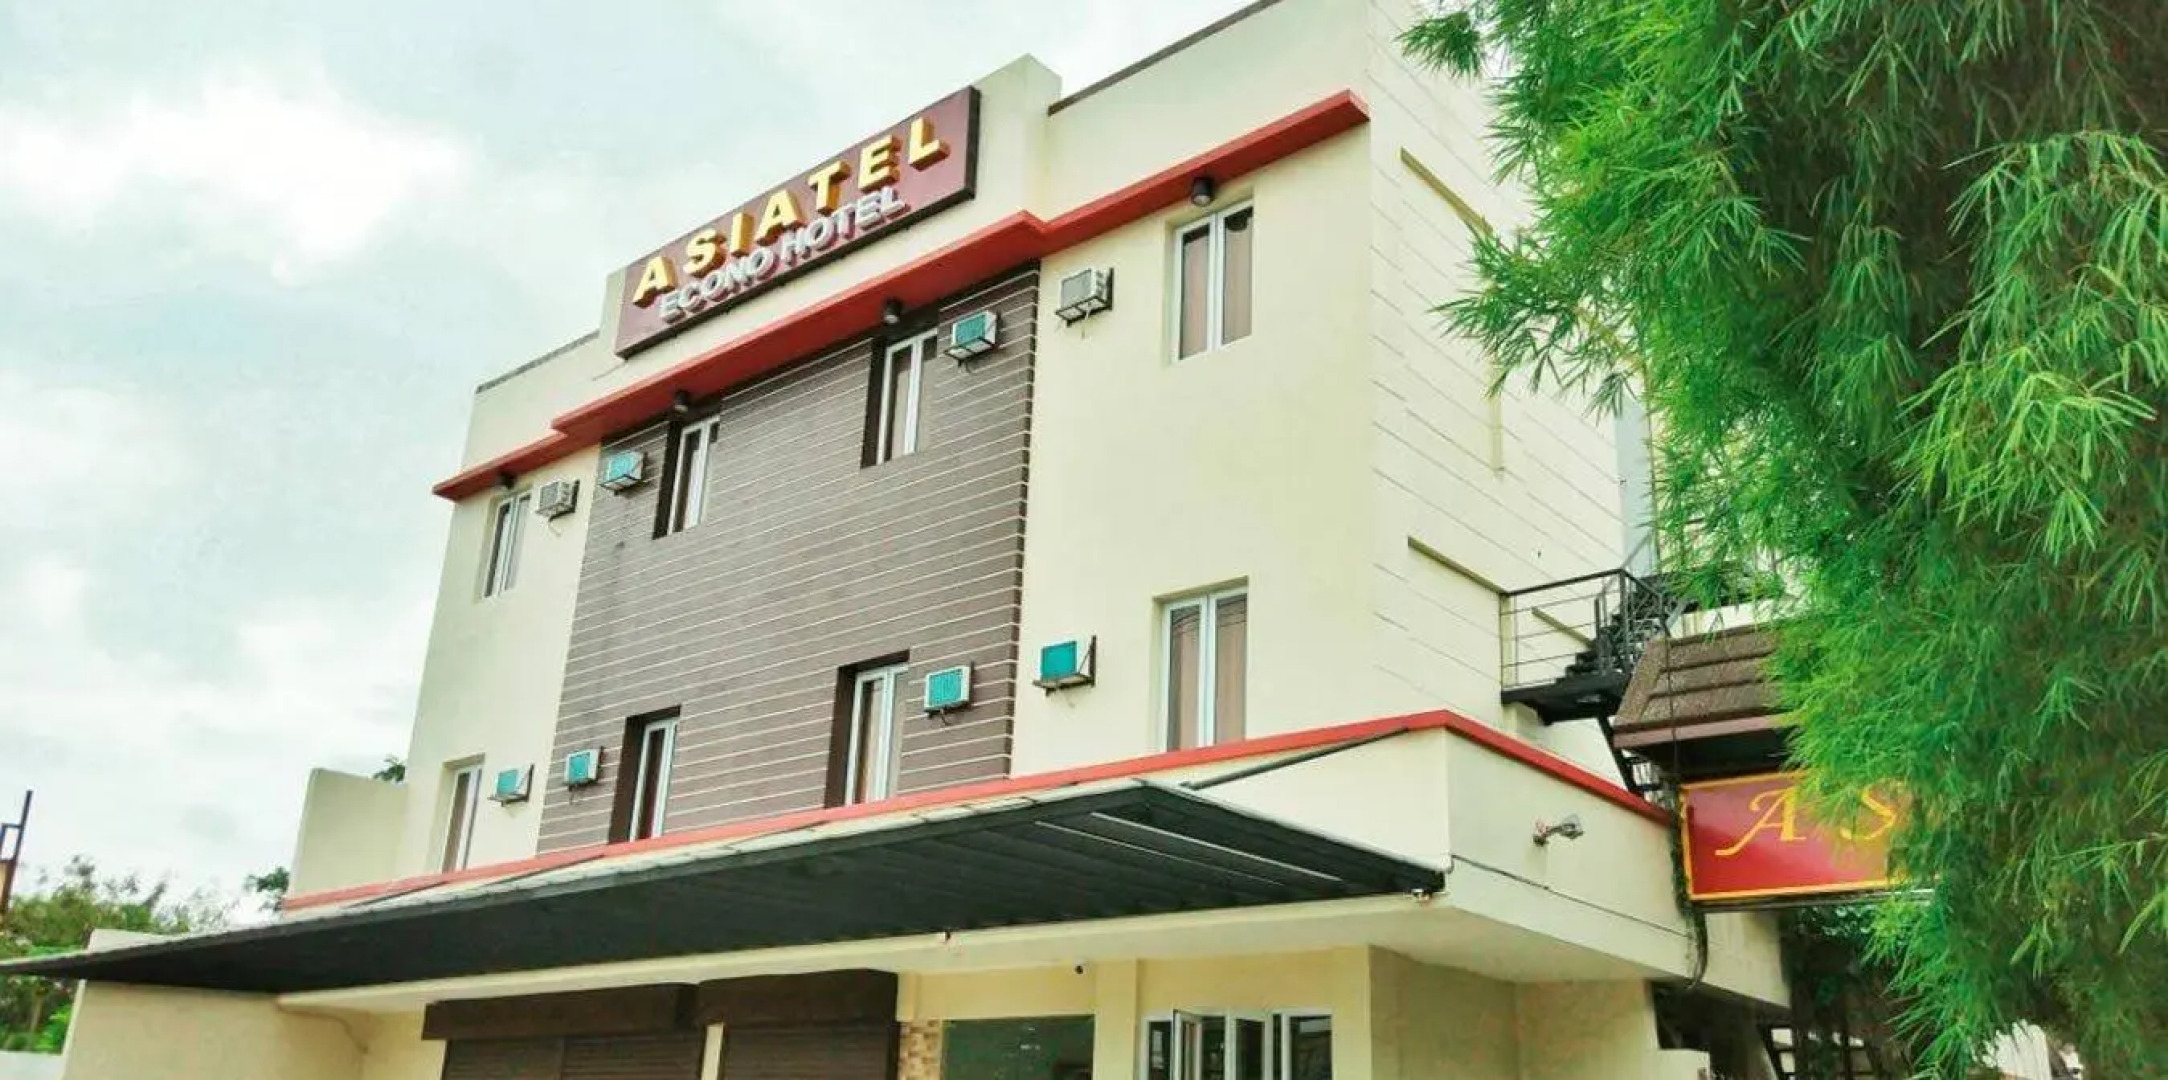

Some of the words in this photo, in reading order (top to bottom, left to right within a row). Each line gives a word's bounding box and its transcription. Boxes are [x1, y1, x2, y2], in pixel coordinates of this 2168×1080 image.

[632, 117, 951, 307] ASIATEL
[660, 252, 780, 323] ECONO
[779, 187, 910, 264] HOTEL
